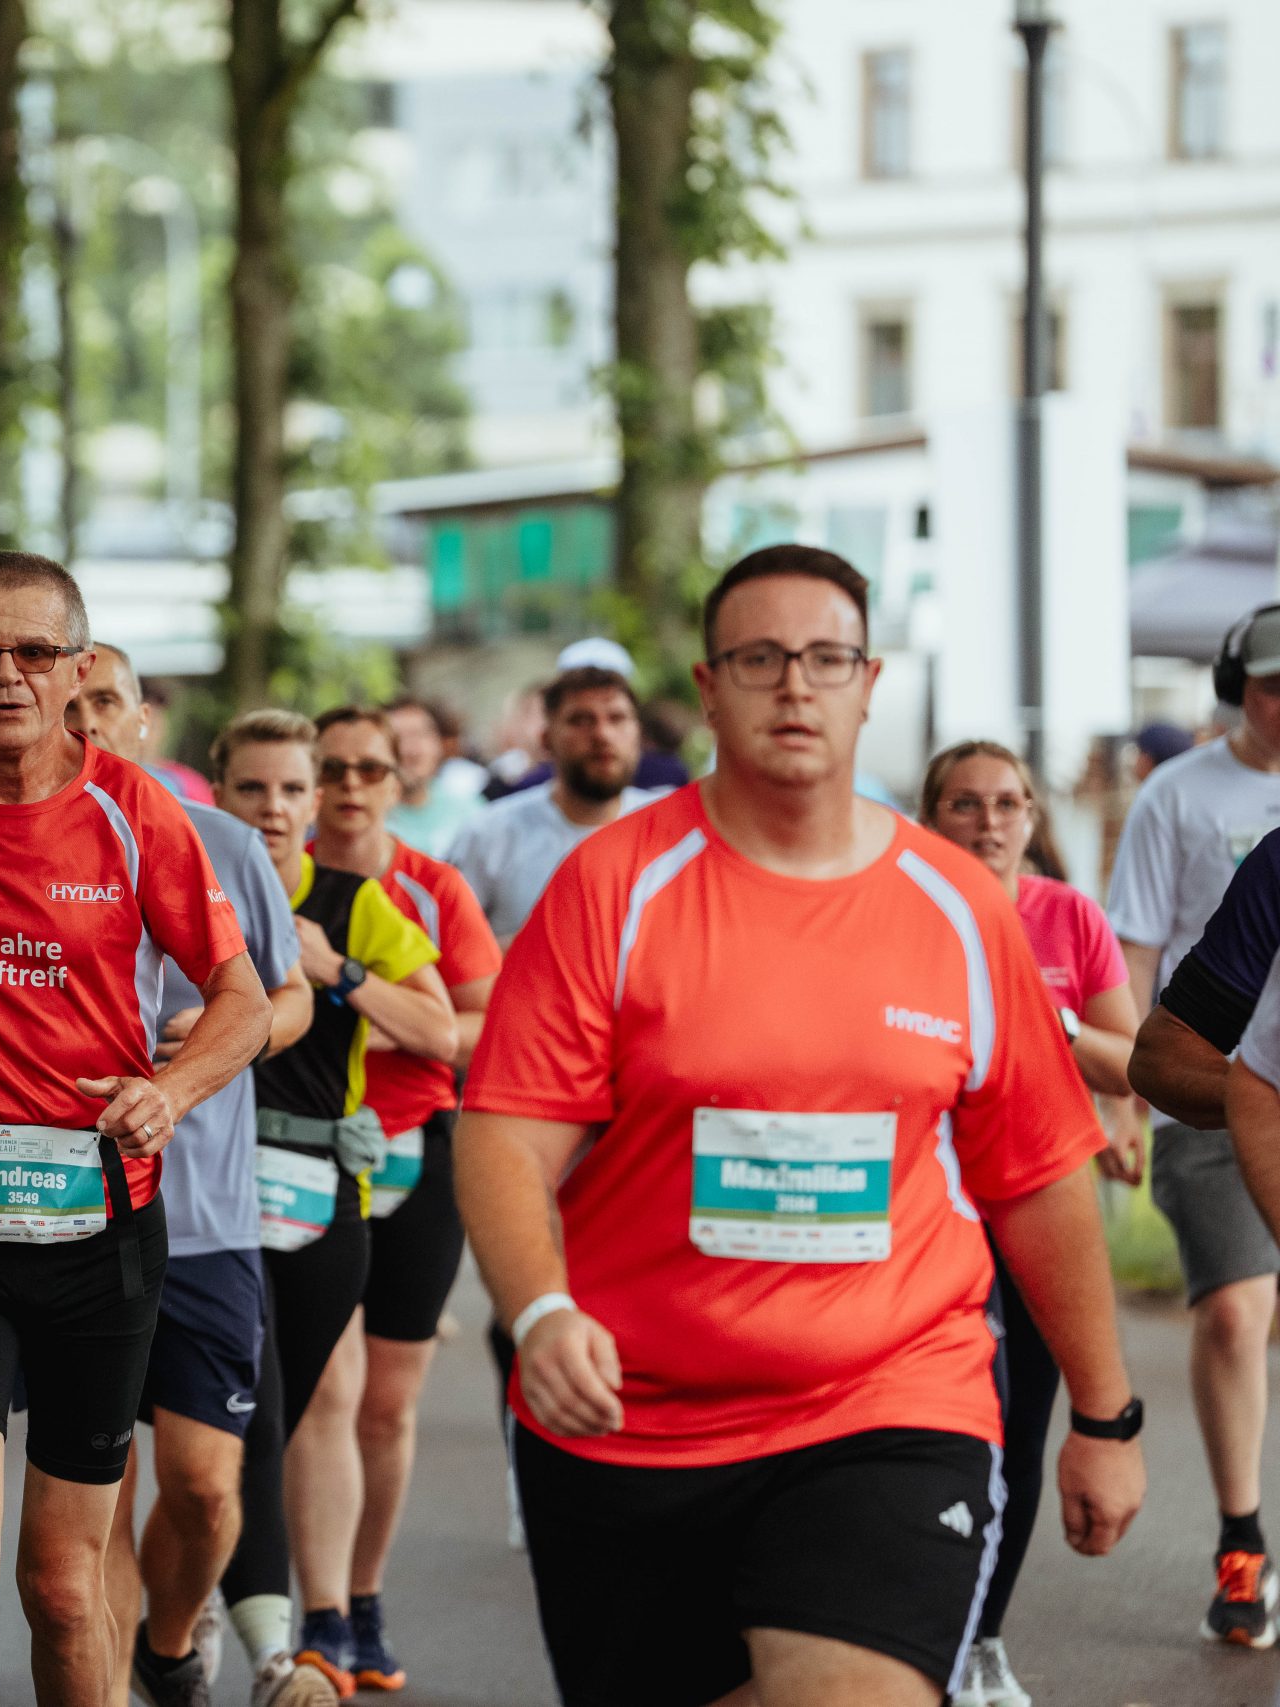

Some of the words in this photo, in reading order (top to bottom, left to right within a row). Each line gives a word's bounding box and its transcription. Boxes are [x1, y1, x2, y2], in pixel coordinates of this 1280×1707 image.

[50, 883, 121, 903] HYDAC
[720, 1158, 868, 1193] Maximilian
[7, 1191, 40, 1205] 3549
